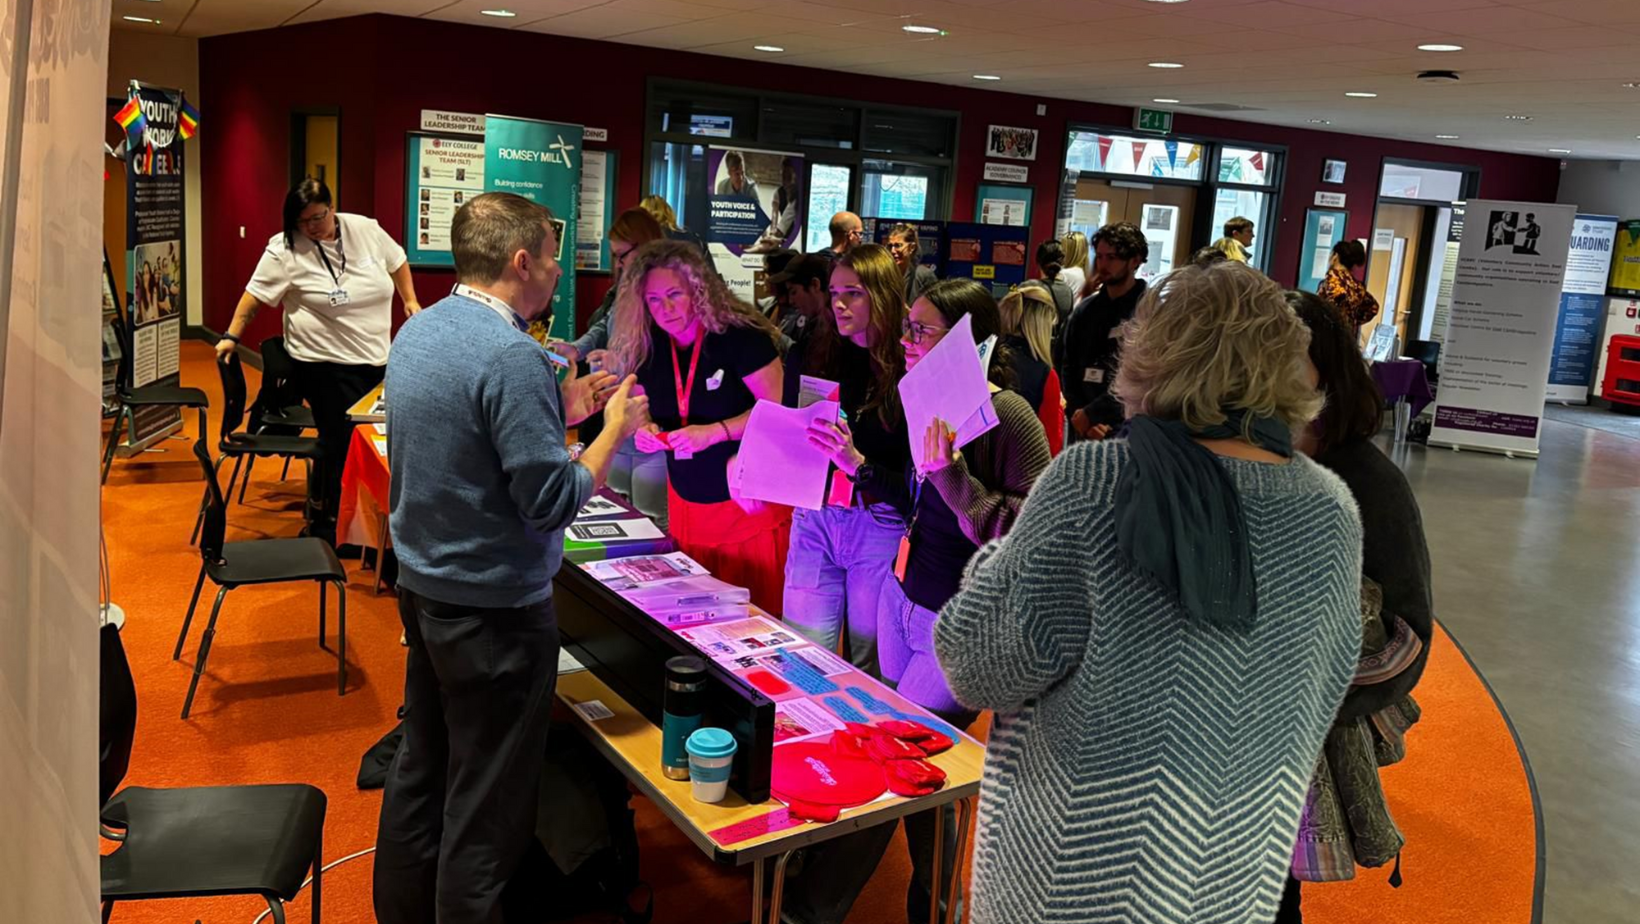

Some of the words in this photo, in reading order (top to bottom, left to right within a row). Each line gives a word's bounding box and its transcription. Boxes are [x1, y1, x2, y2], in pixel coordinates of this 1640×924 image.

[140, 99, 177, 123] YOUTH
[450, 115, 476, 123] SENIOR
[424, 121, 467, 130] LEADERSHIP
[467, 124, 485, 132] TEAM
[453, 142, 478, 150] COLLEGE
[498, 147, 539, 162] ROMSEY
[540, 152, 563, 163] MILL
[494, 179, 515, 188] Building
[516, 181, 543, 189] confidence
[711, 201, 732, 209] YOUTH
[732, 202, 750, 210] VOICE
[711, 210, 756, 220] PARTICIPATION
